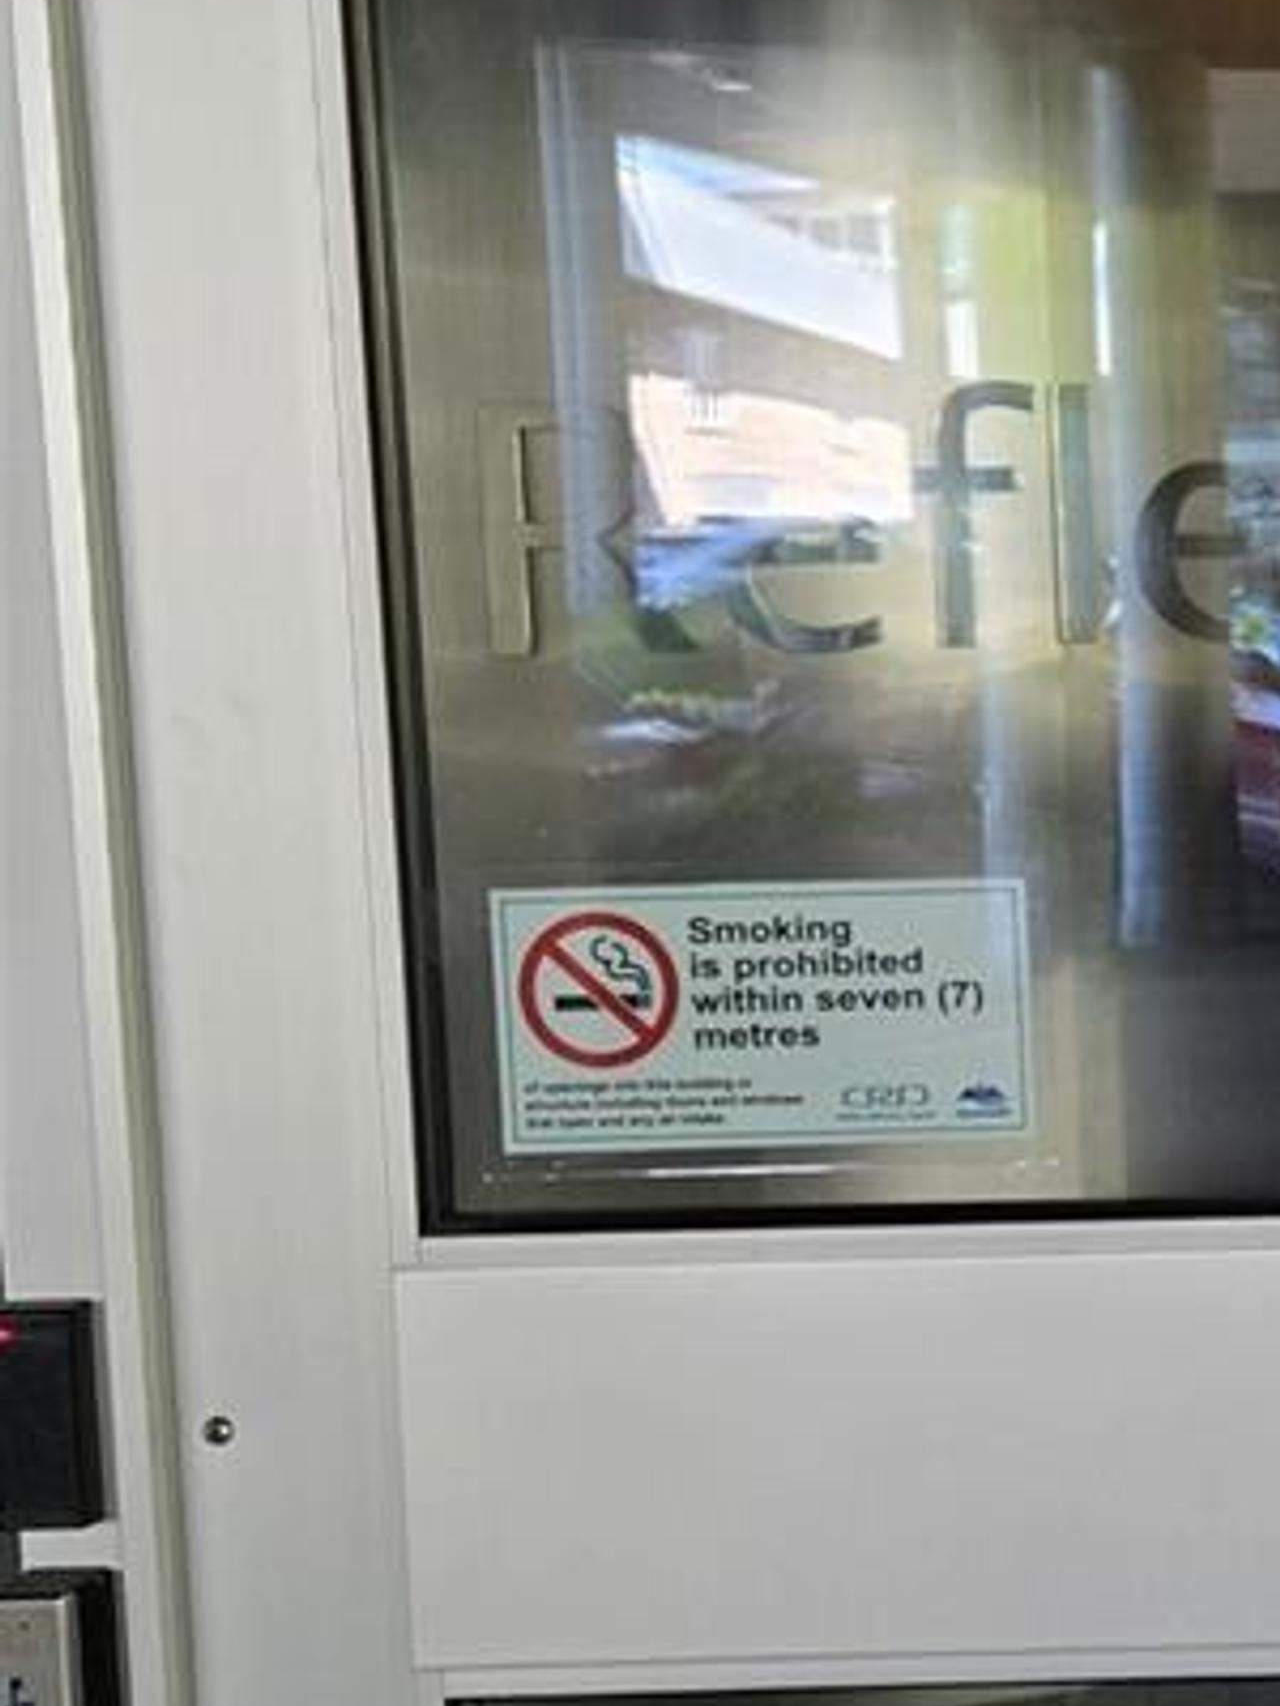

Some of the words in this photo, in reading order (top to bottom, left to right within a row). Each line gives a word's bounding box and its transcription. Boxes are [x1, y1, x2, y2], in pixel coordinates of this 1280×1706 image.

[687, 914, 852, 948] Smoking
[690, 950, 722, 979] is
[733, 946, 924, 983] prohibited
[690, 985, 804, 1015] within
[814, 987, 925, 1013] seven
[937, 979, 984, 1018] (7)
[694, 1023, 821, 1050] metres
